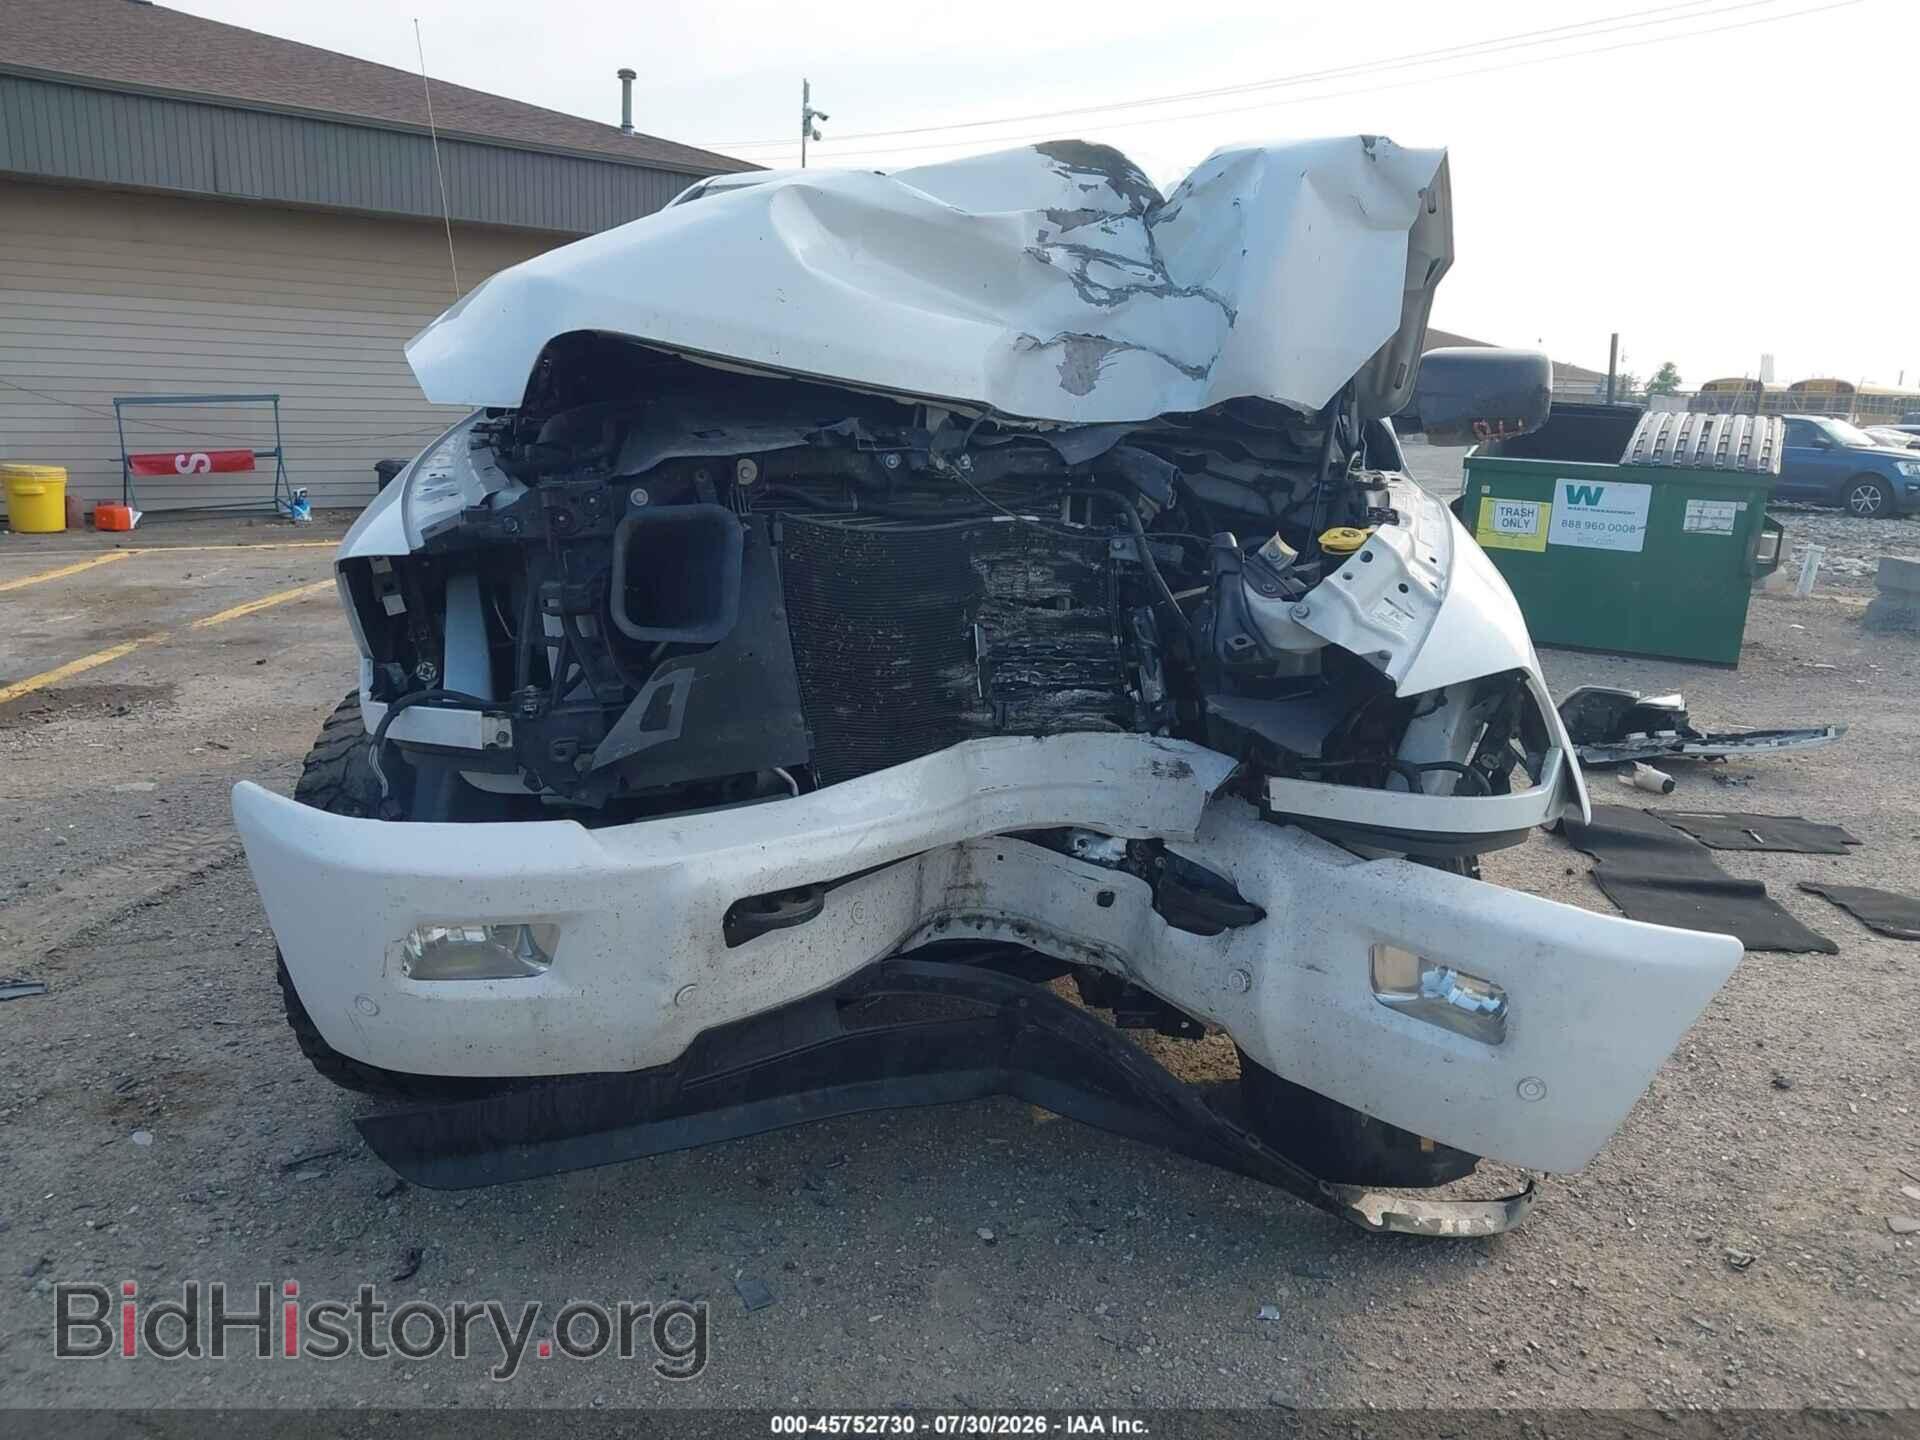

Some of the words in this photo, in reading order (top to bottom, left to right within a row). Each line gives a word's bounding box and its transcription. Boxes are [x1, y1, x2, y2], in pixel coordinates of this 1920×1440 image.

[1500, 506, 1535, 518] TRASH
[1501, 518, 1531, 530] ONLY
[1561, 519, 1582, 529] 888
[1584, 521, 1606, 531] 960
[1607, 523, 1637, 534] 0008
